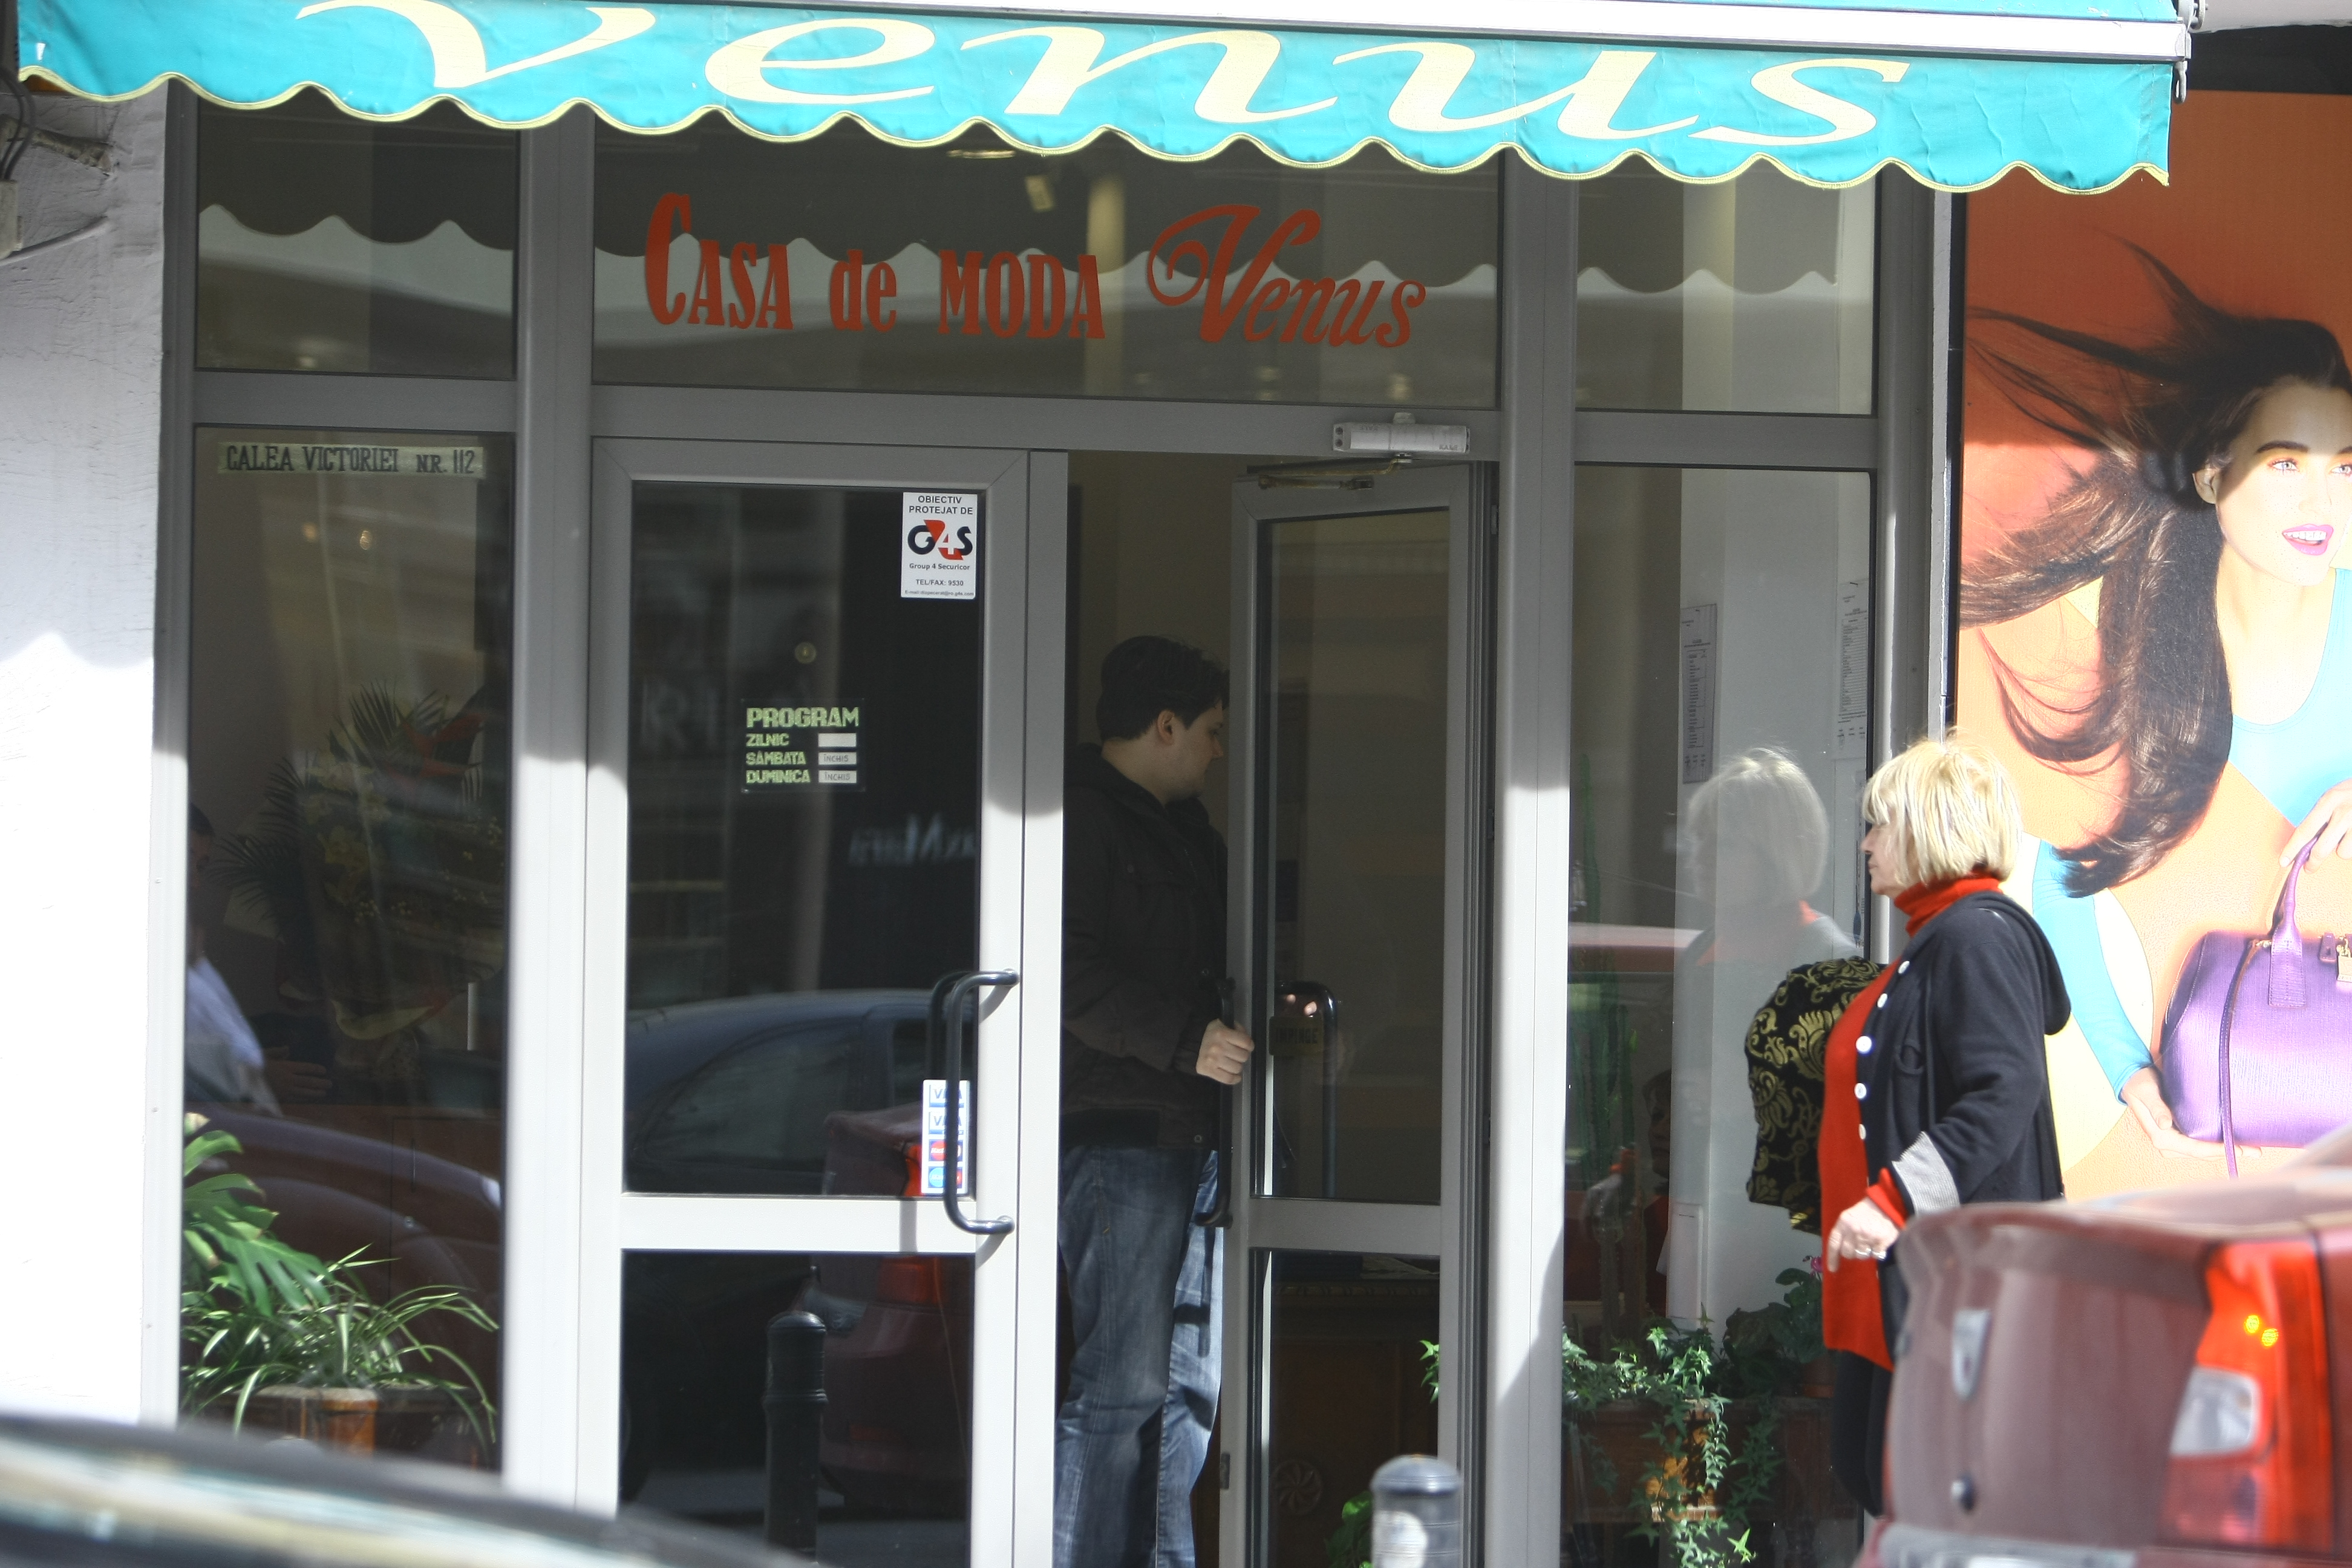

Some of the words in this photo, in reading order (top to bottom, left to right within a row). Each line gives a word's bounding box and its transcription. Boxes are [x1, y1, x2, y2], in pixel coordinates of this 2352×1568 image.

[645, 192, 792, 331] CASA
[829, 249, 897, 332] de
[938, 250, 1106, 339] MODA
[1145, 204, 1426, 348] Venus
[227, 445, 295, 471] CALEA
[302, 446, 399, 472] VICTORIEI
[416, 454, 447, 473] NR.
[453, 449, 475, 474] 112
[909, 506, 958, 514] PROTEJAT
[907, 520, 973, 560] G4S
[746, 707, 859, 728] PROGRAM
[746, 733, 789, 746] ZILNIC
